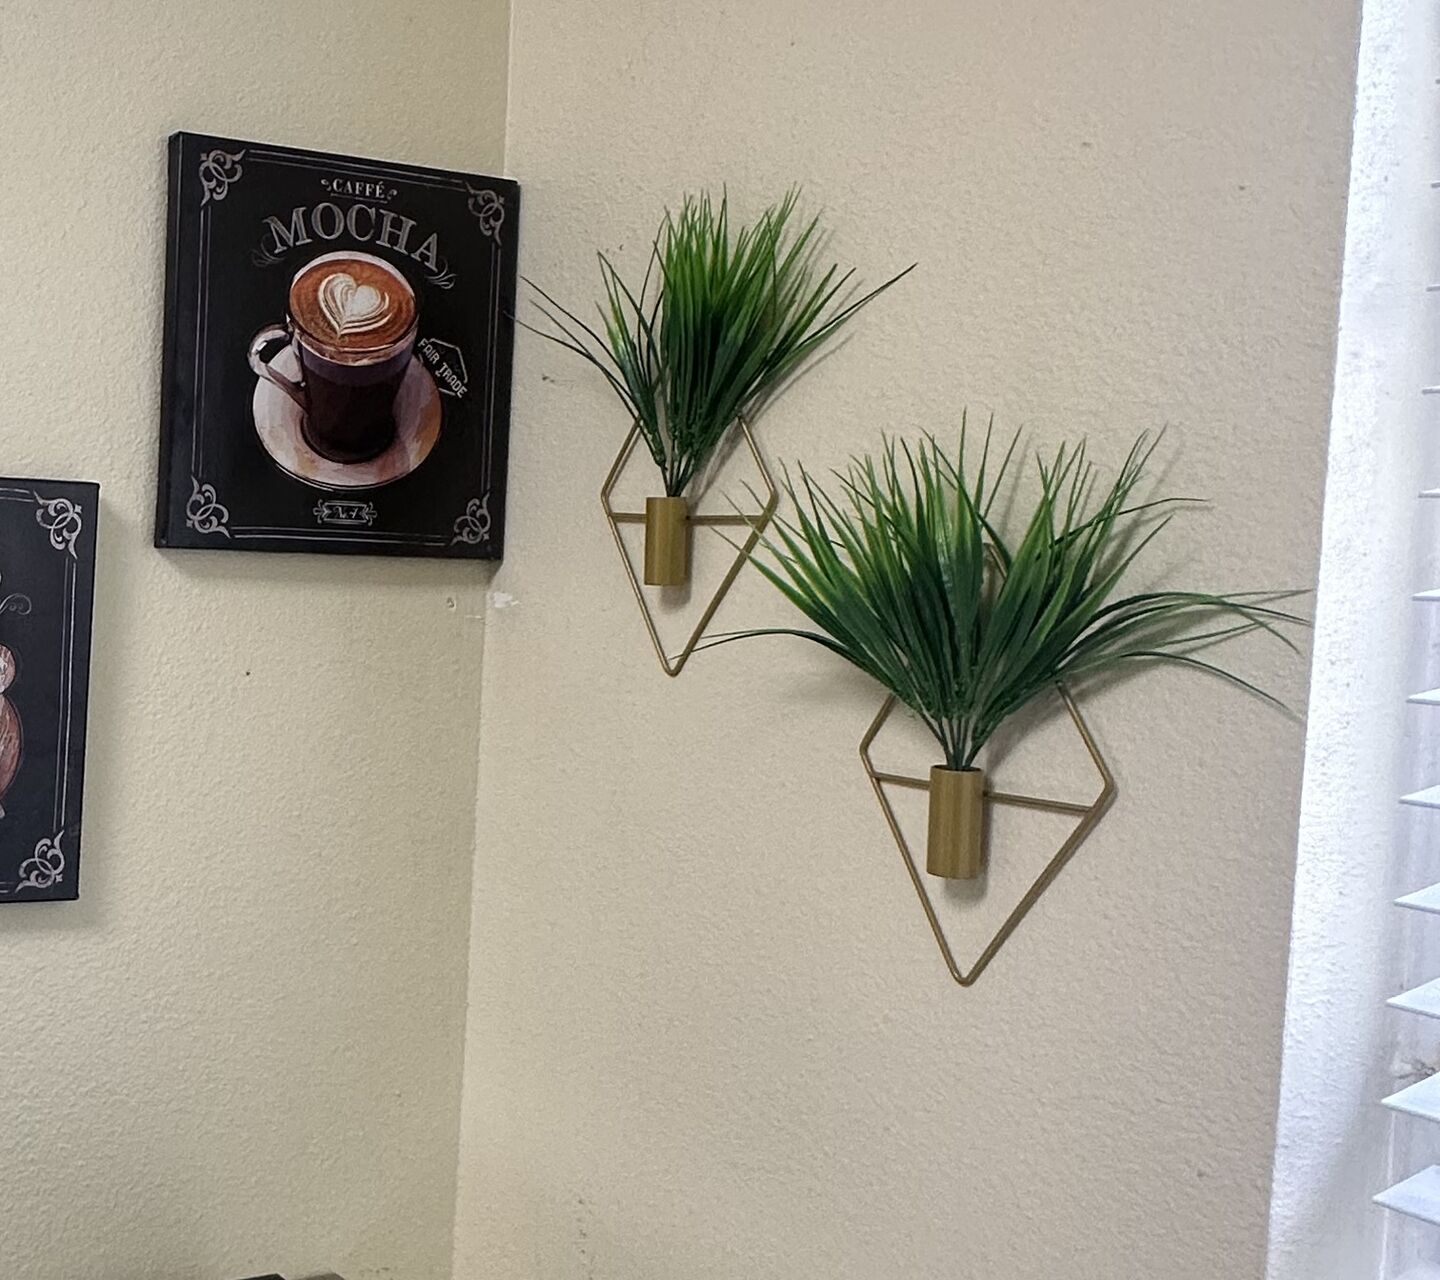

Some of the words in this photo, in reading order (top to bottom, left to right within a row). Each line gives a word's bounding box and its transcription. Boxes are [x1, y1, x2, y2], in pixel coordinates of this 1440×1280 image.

[262, 202, 439, 273] MOCHA
[417, 337, 441, 366] FAIR
[434, 361, 468, 399] TRADE
